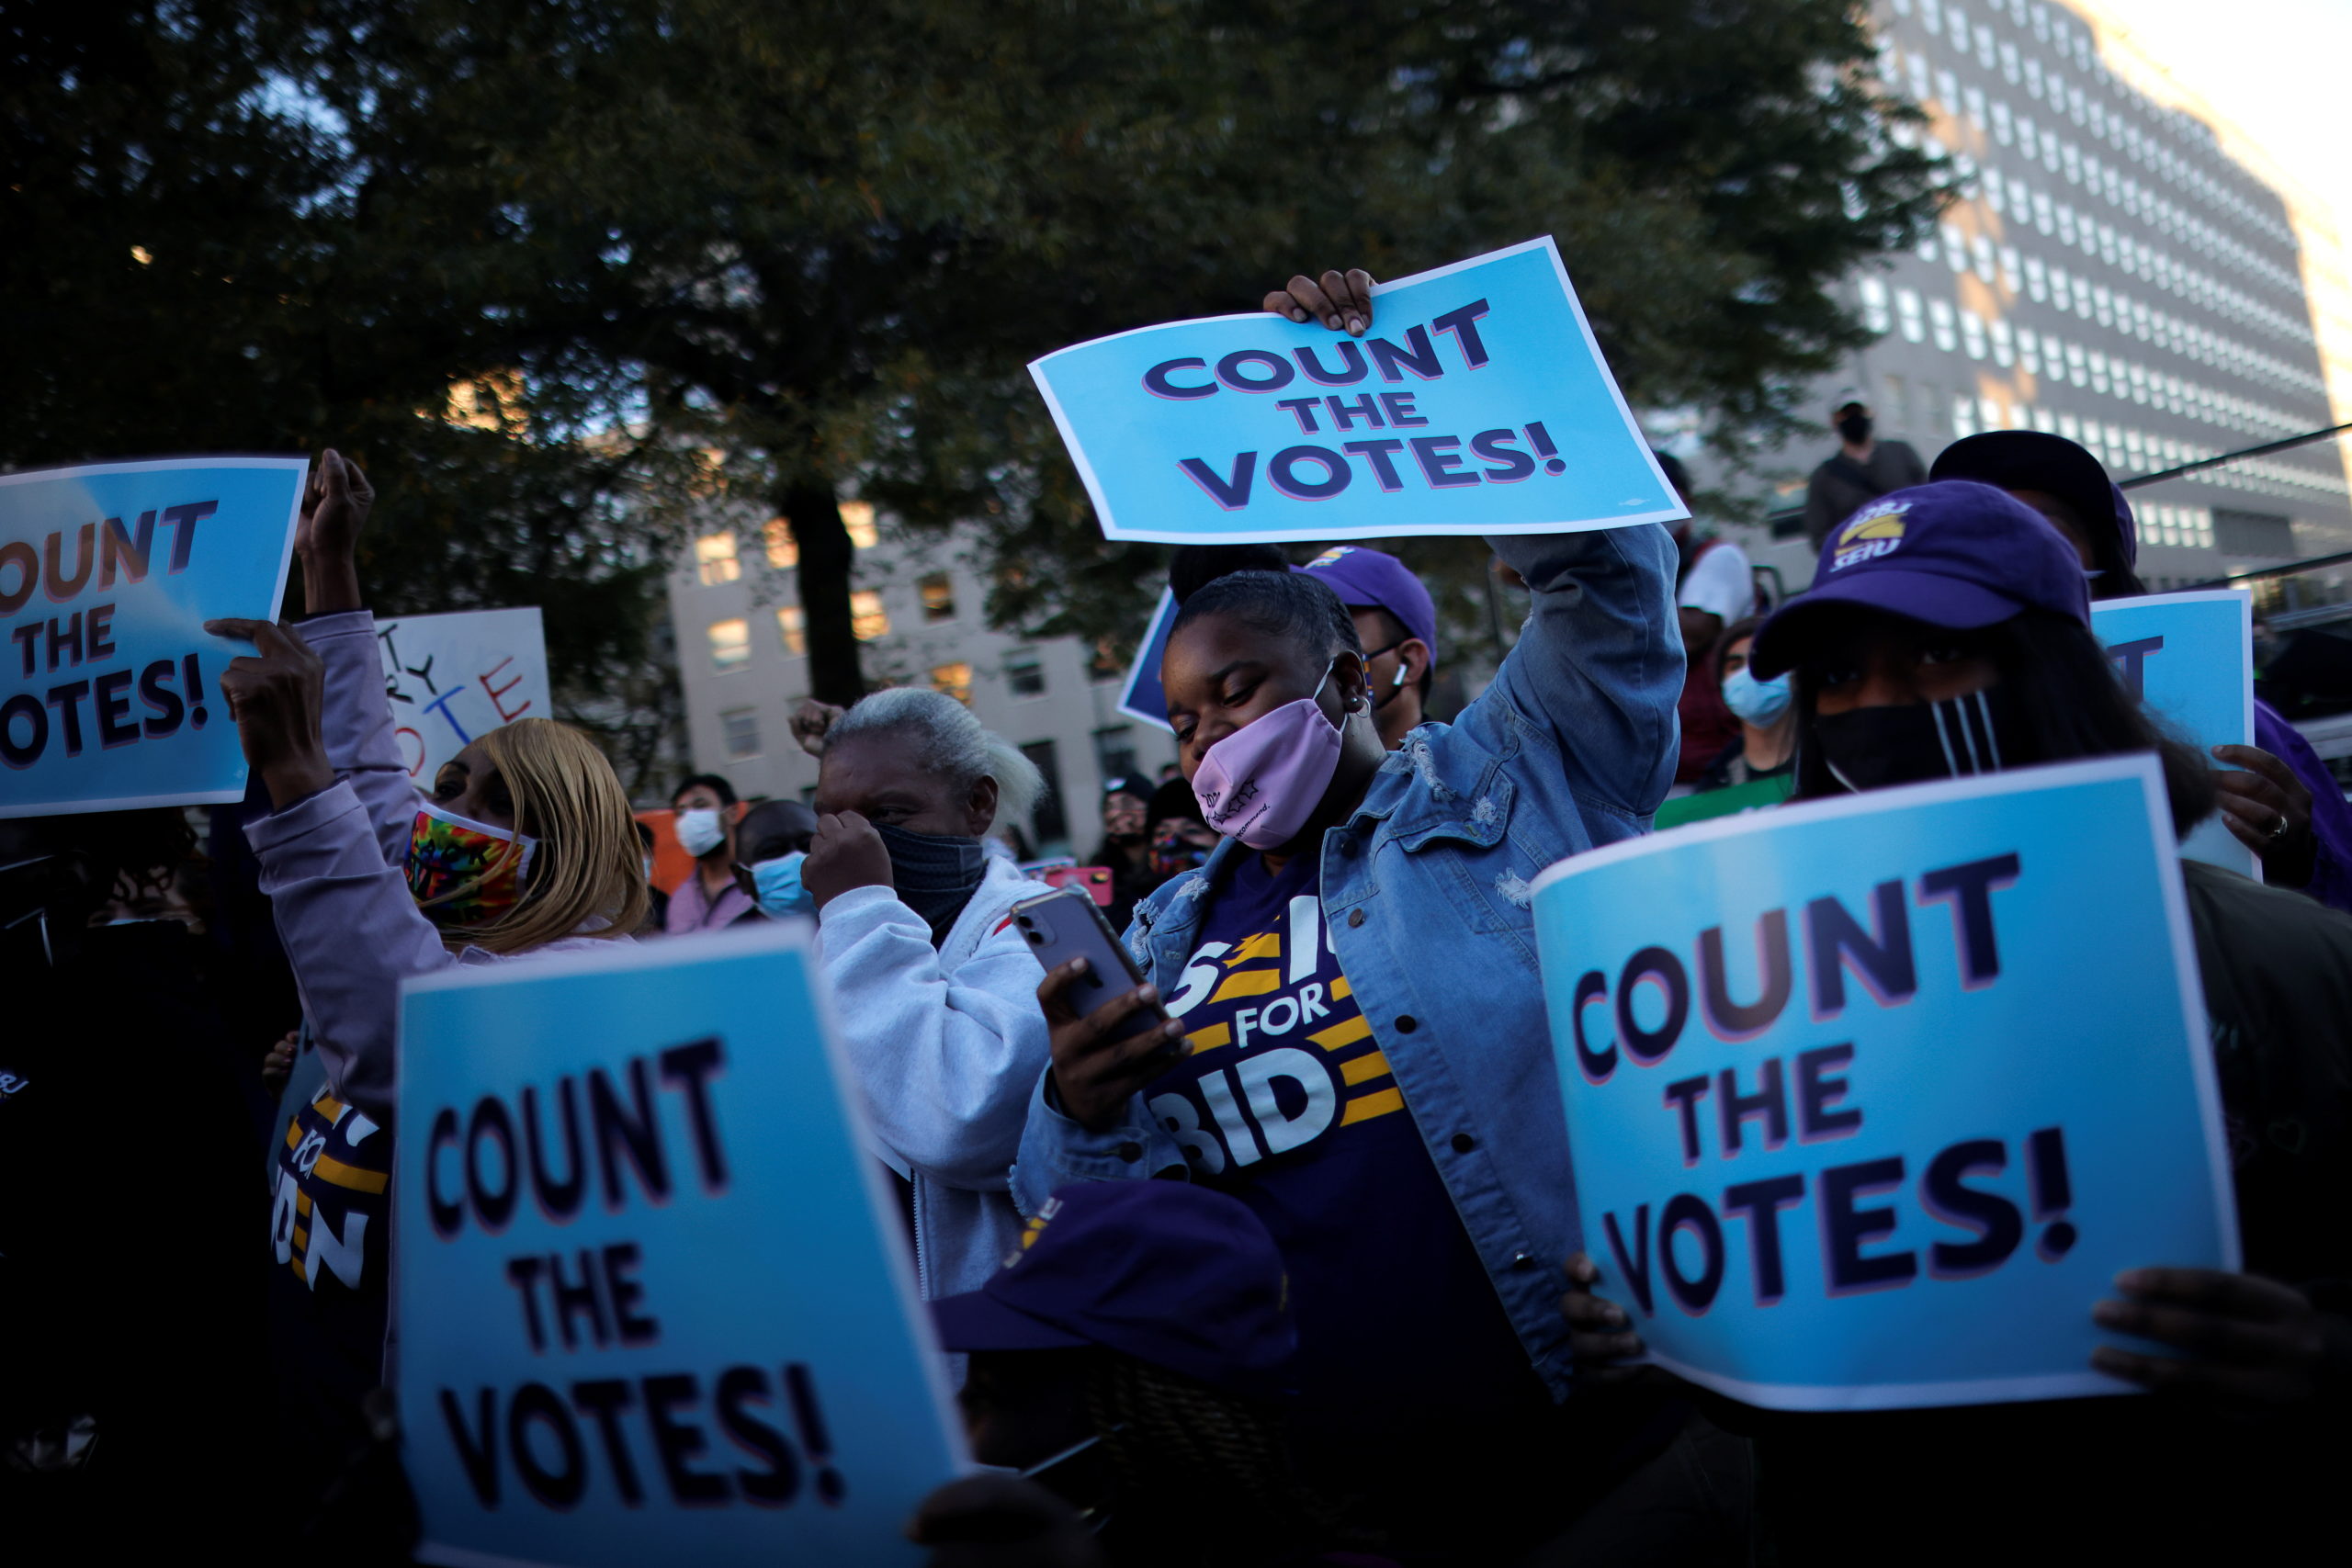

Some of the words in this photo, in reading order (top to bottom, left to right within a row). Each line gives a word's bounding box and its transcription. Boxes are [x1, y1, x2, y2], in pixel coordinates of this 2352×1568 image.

[1142, 299, 1490, 400] COUNT
[1177, 422, 1566, 511] VOTES!
[1276, 392, 1429, 434] THE
[12, 604, 116, 680] THE
[396, 657, 531, 777] OTE
[1236, 982, 1330, 1049] FOR
[1571, 852, 2022, 1087] COUNT
[426, 1036, 730, 1242] COUNT
[1664, 1043, 1863, 1168] THE
[1603, 1126, 2077, 1318] VOTES!
[505, 1243, 659, 1354] THE
[438, 1362, 845, 1513] VOTES!
